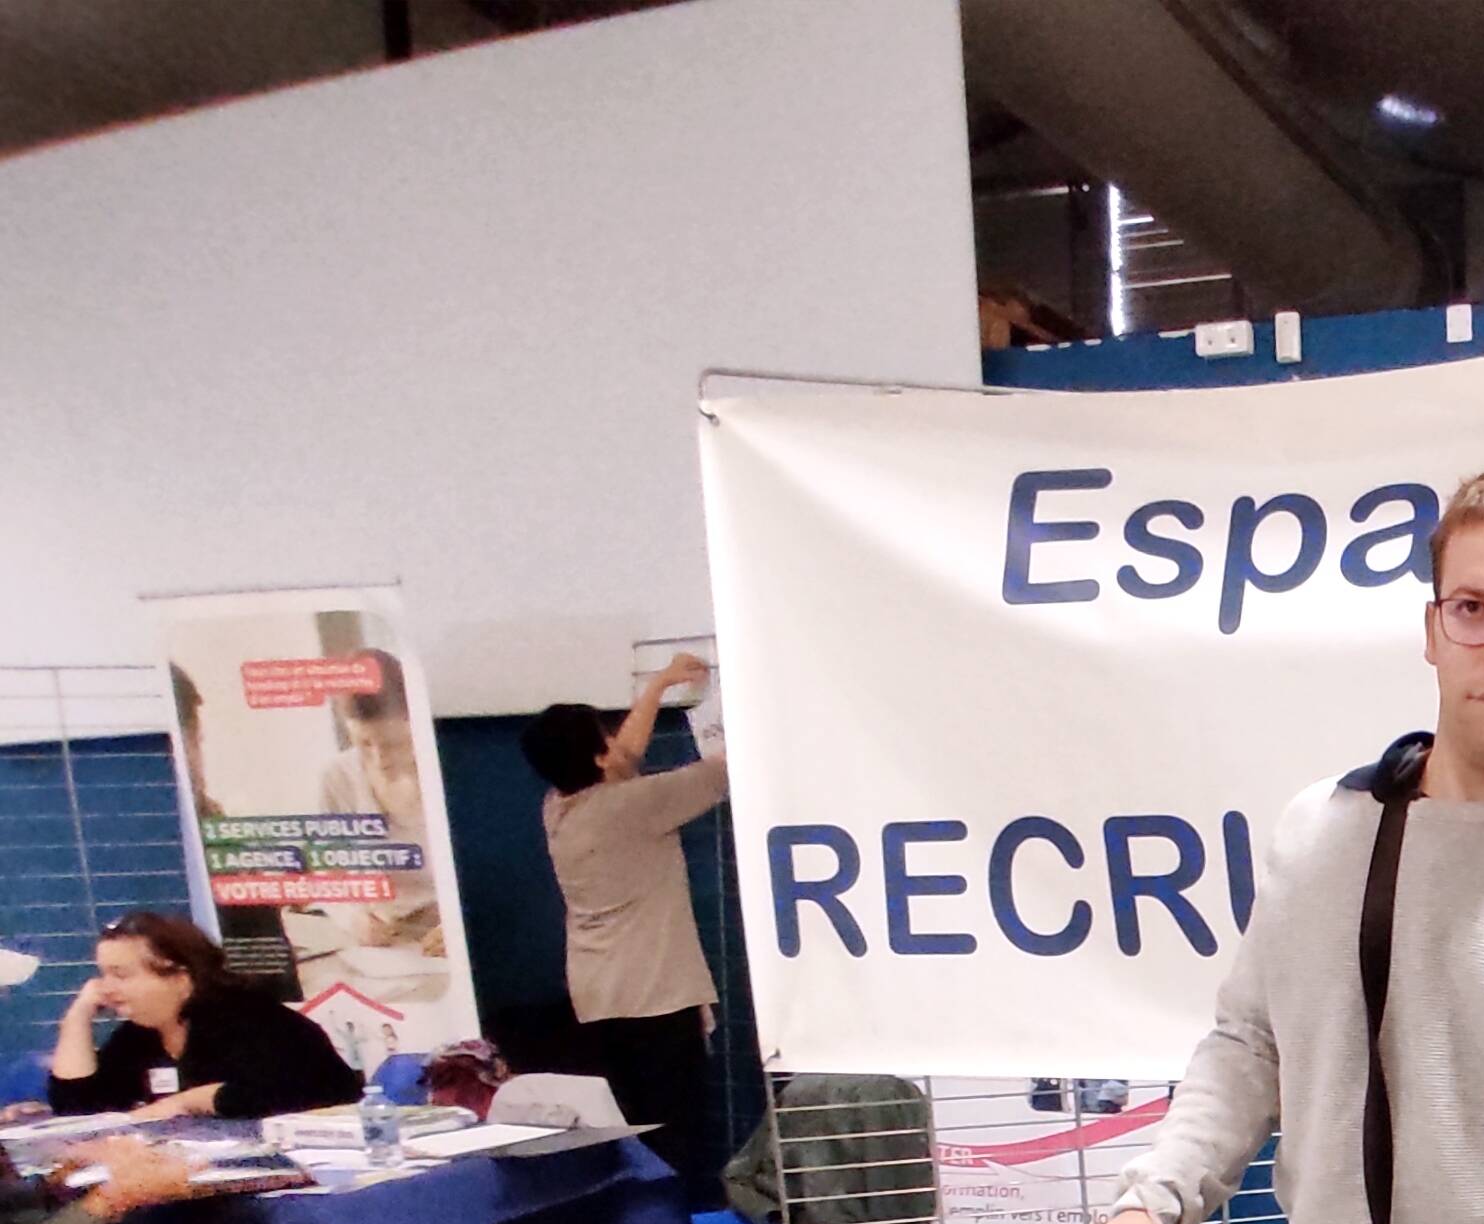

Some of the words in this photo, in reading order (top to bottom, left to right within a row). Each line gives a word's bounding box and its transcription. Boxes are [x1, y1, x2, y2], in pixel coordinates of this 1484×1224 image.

[219, 820, 304, 839] SERVICES
[224, 850, 301, 870] AGENCE,
[310, 850, 322, 867] 1
[323, 848, 410, 868] OBJECTIF
[216, 881, 281, 899] VOTRE
[283, 876, 378, 899] RÉUSSITE
[936, 1145, 975, 1164] TER
[941, 1183, 1025, 1201] ormation,
